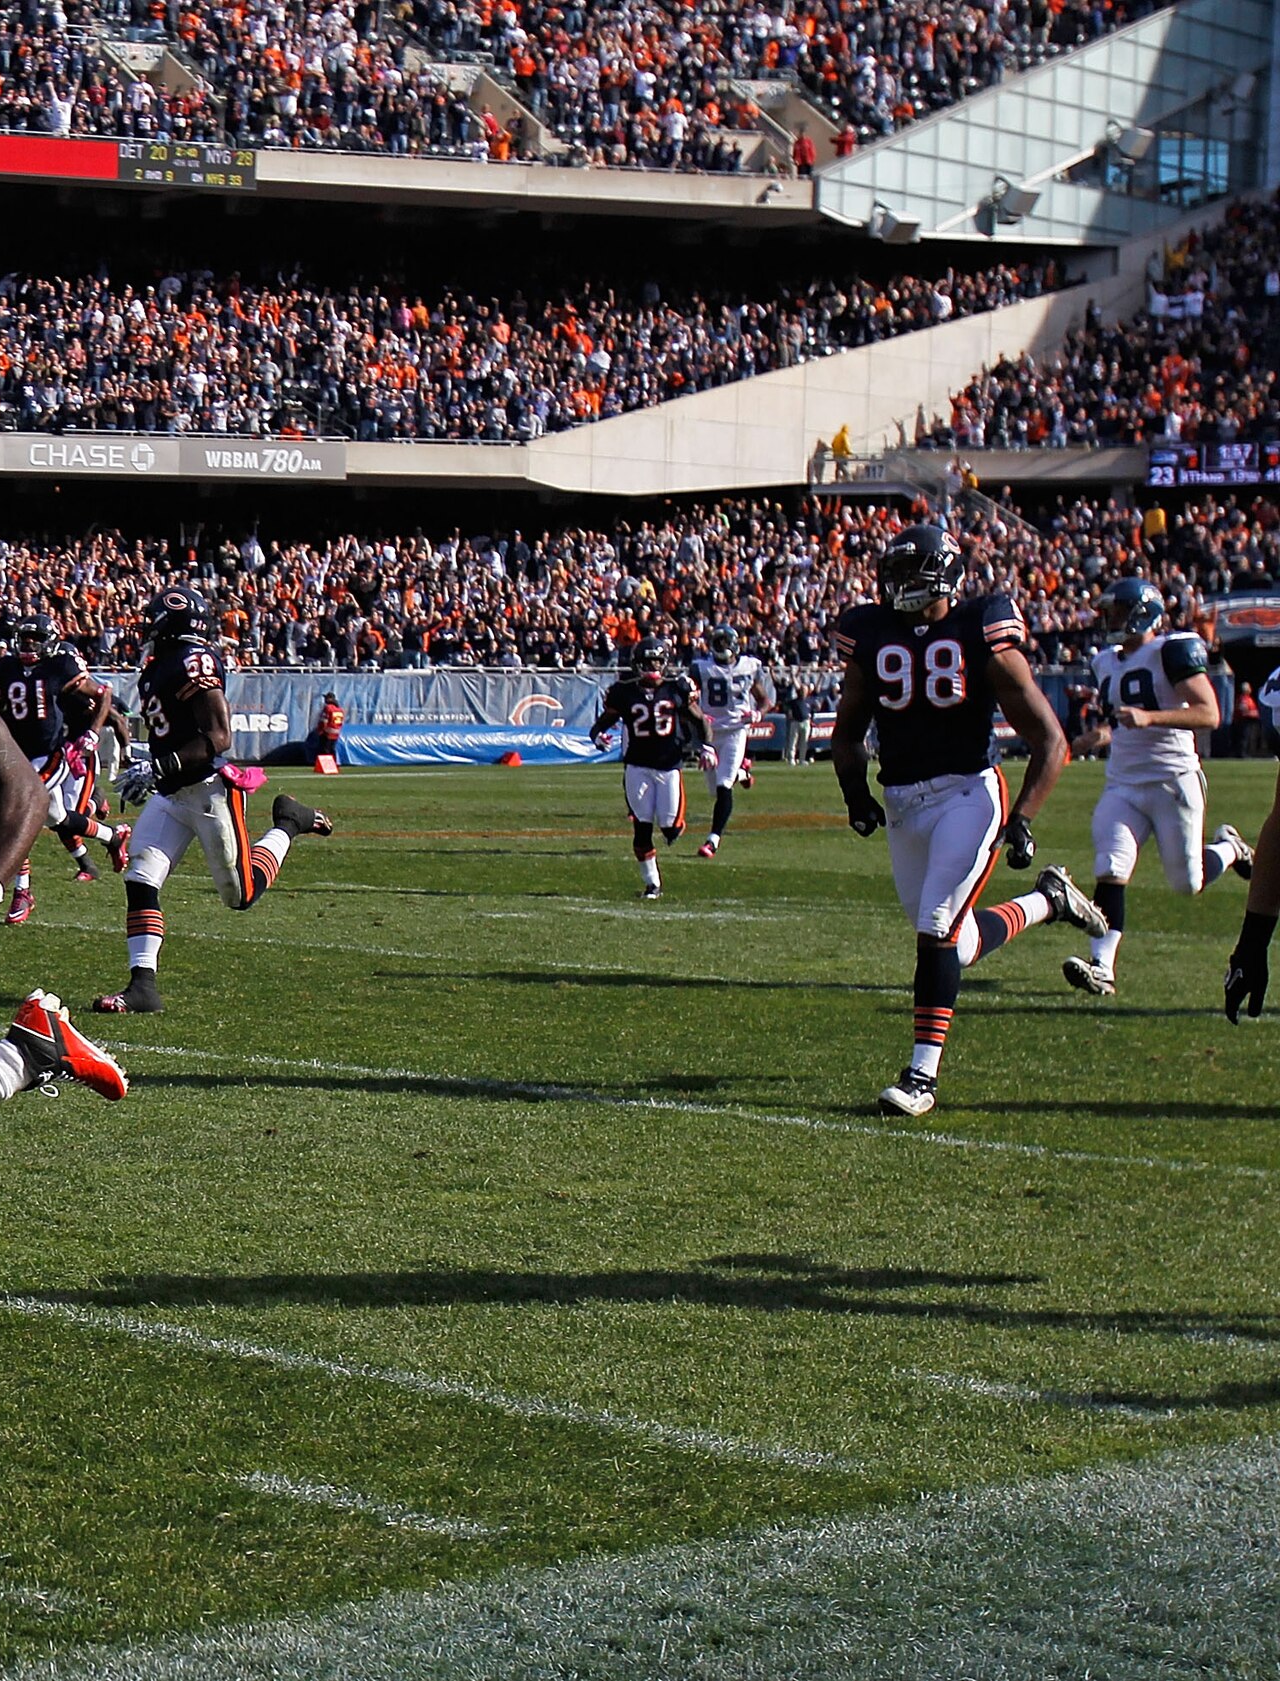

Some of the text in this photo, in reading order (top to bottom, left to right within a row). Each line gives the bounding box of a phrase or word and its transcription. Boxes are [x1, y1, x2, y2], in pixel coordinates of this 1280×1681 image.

[120, 143, 167, 161] DET 20
[205, 149, 232, 165] NYG
[29, 443, 125, 468] CHASE
[204, 450, 259, 470] WBBM
[183, 653, 216, 679] 58
[876, 639, 966, 711] 98
[8, 679, 47, 721] 81
[230, 713, 288, 732] ARS
[631, 699, 675, 739] 26
